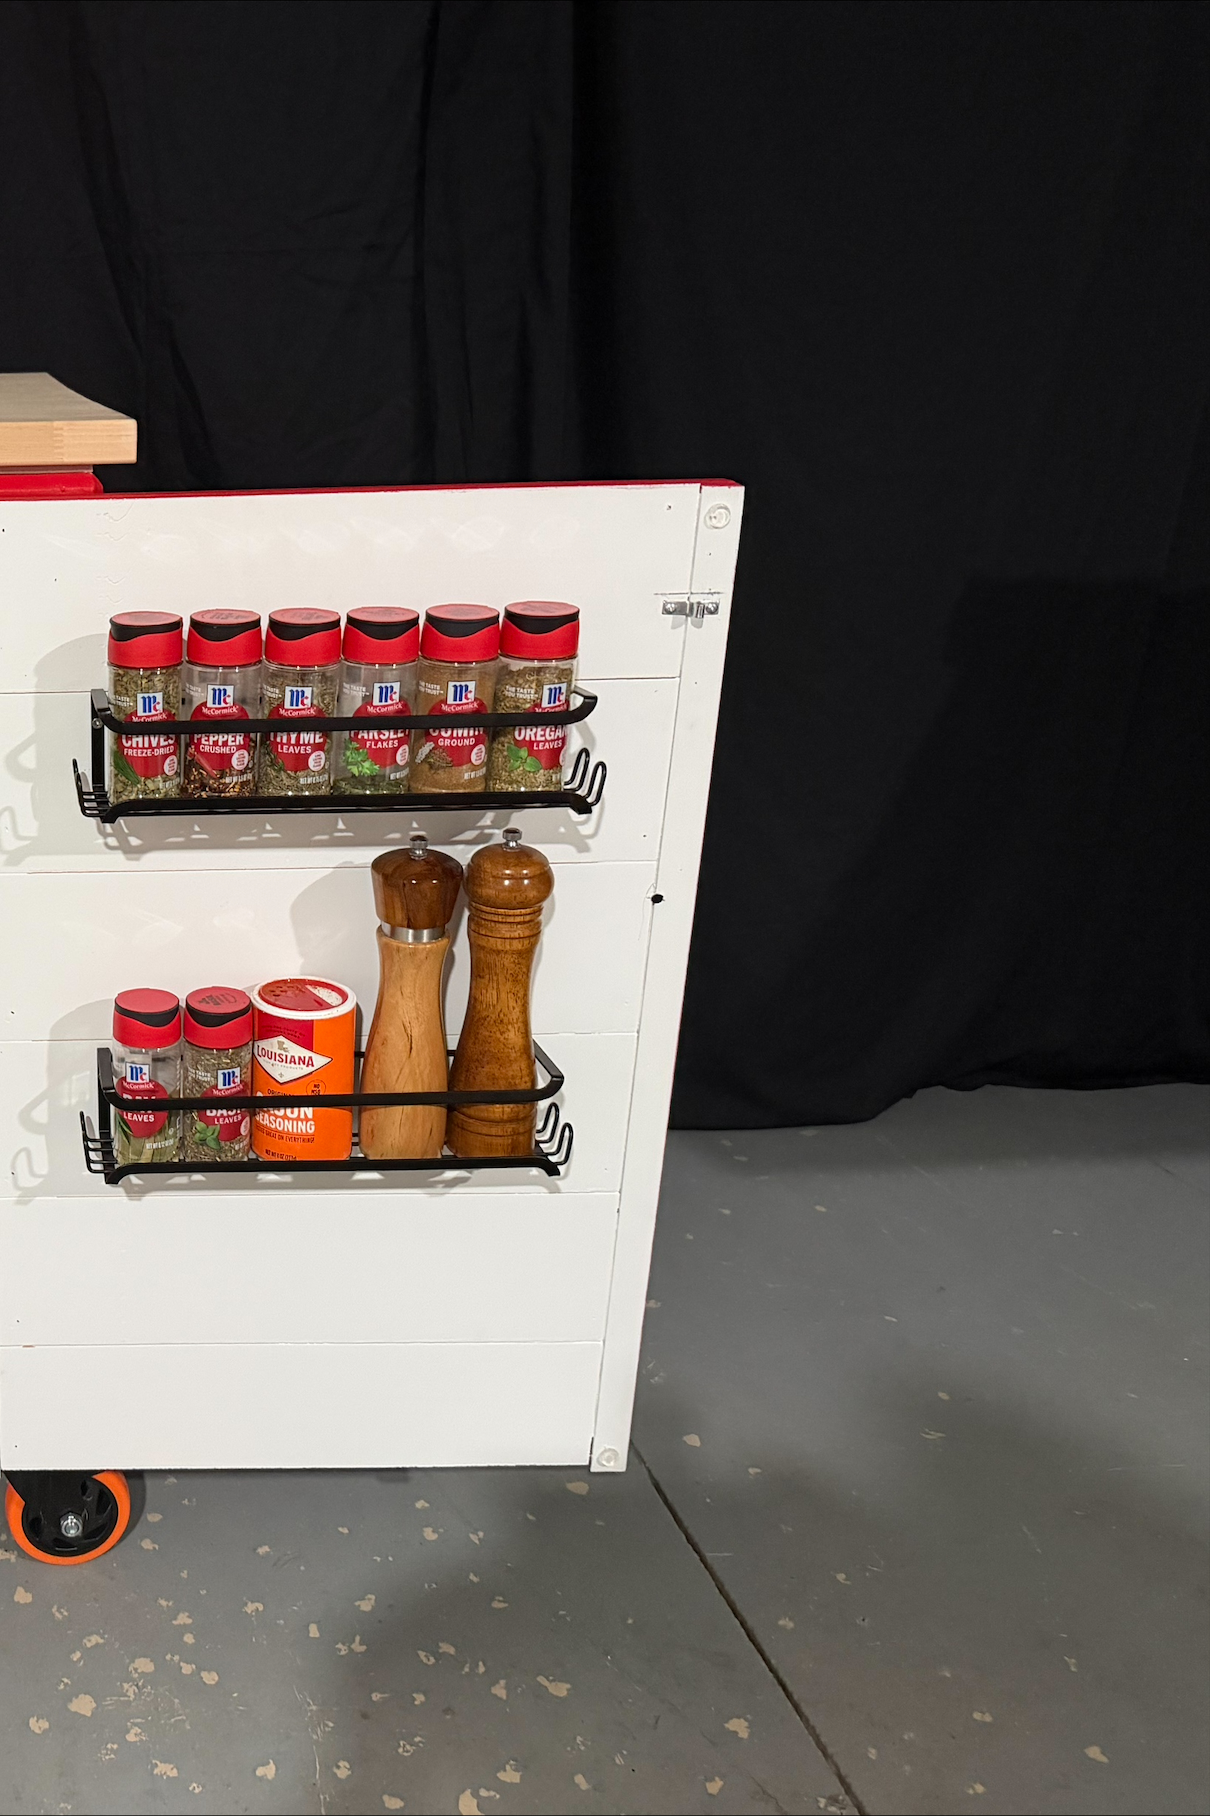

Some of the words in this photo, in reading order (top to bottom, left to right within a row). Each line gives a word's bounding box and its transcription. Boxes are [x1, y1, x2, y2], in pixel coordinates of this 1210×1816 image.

[202, 706, 239, 715] McCormick
[279, 707, 316, 717] McCormick
[367, 702, 403, 714] McCormick
[441, 701, 479, 713] McCormick
[122, 734, 175, 748] CHIVES
[194, 733, 244, 745] PEPPER
[269, 730, 324, 744] THYME
[438, 738, 476, 747] GROUND
[199, 745, 237, 754] CRUSHED
[278, 745, 312, 754] LEAVES
[366, 740, 399, 749] FLAKES
[533, 740, 563, 750] LEAVES
[124, 746, 174, 757] FREEZE-DRIED
[257, 1045, 315, 1068] LOUISIANA
[122, 1081, 155, 1091] McCormick
[212, 1084, 244, 1096] McCormick
[123, 1112, 155, 1122] LEAVES
[214, 1114, 242, 1125] LEAVES
[255, 1111, 316, 1134] SEASONING
